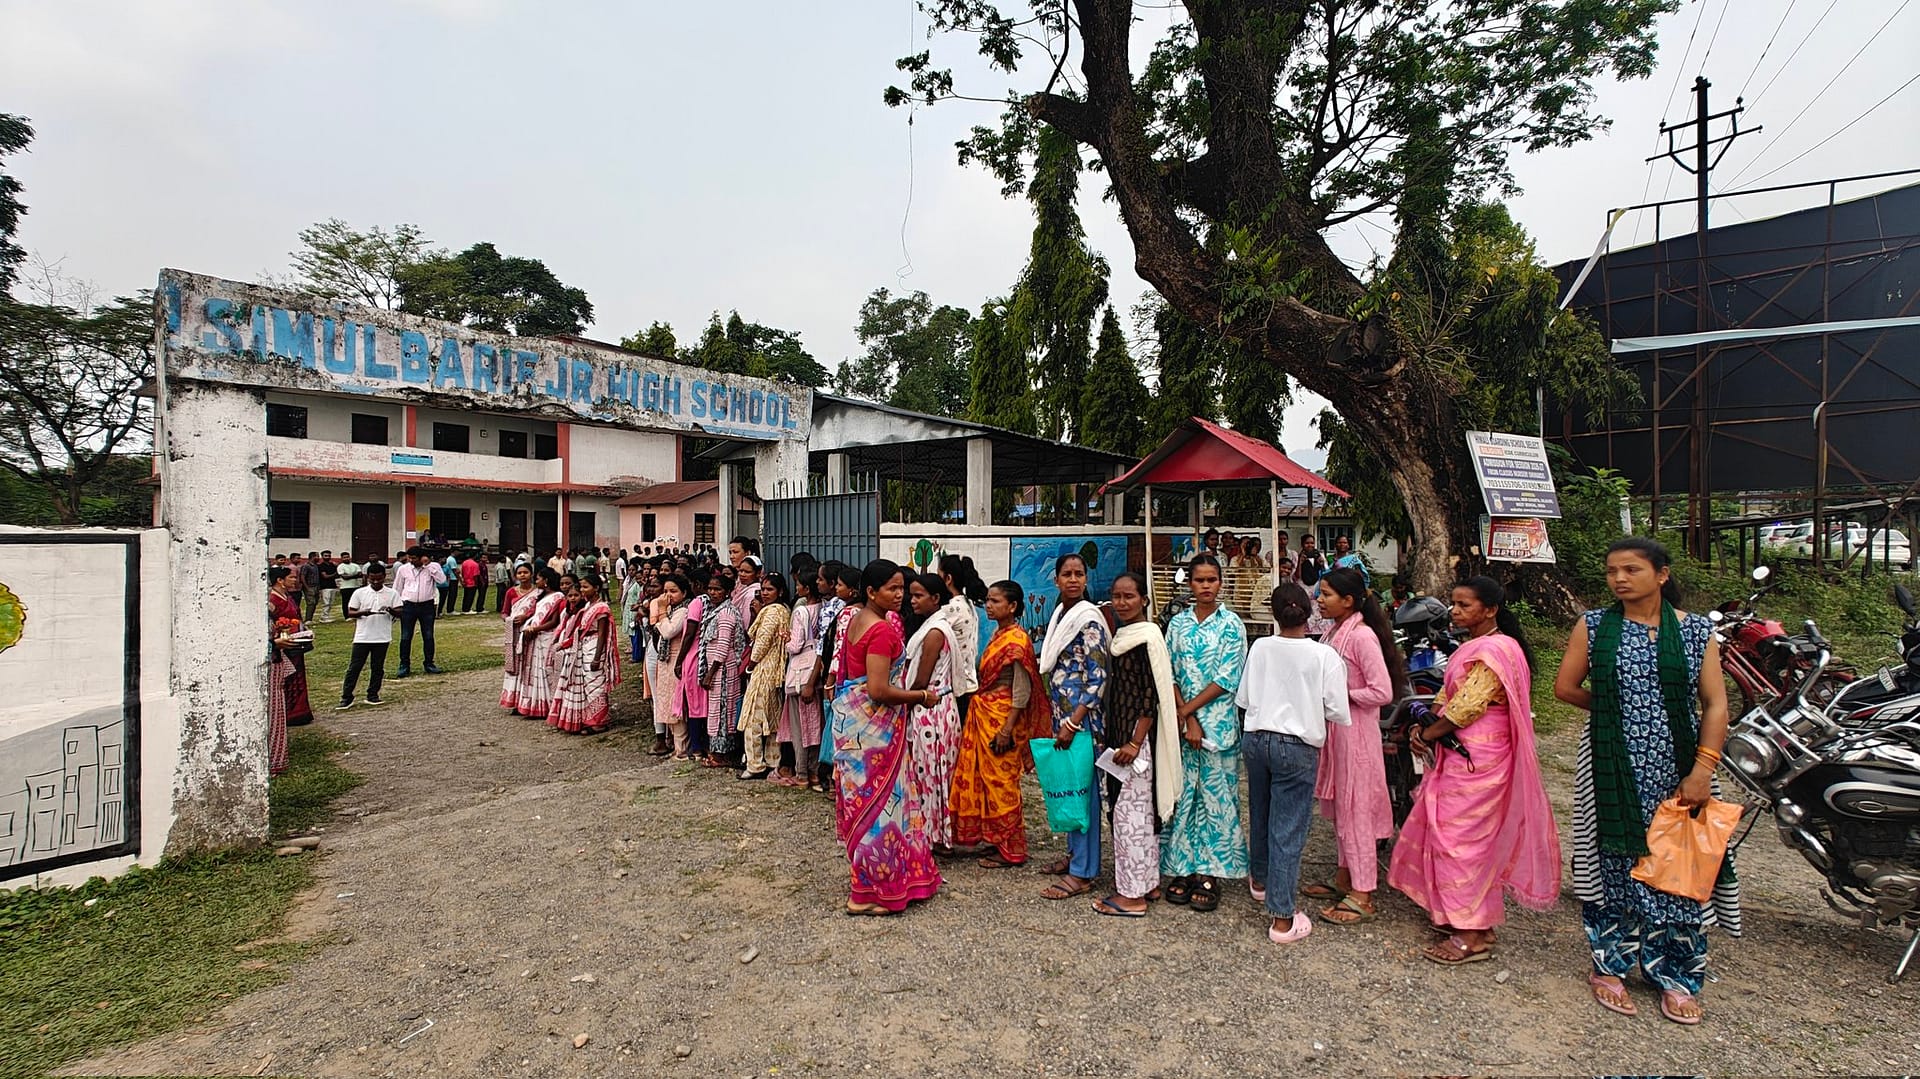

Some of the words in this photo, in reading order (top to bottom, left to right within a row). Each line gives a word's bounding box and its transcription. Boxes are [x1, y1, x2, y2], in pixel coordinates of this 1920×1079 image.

[607, 364, 681, 416] HIGH
[690, 379, 797, 430] SCHOOL
[1046, 790, 1074, 799] THANK
